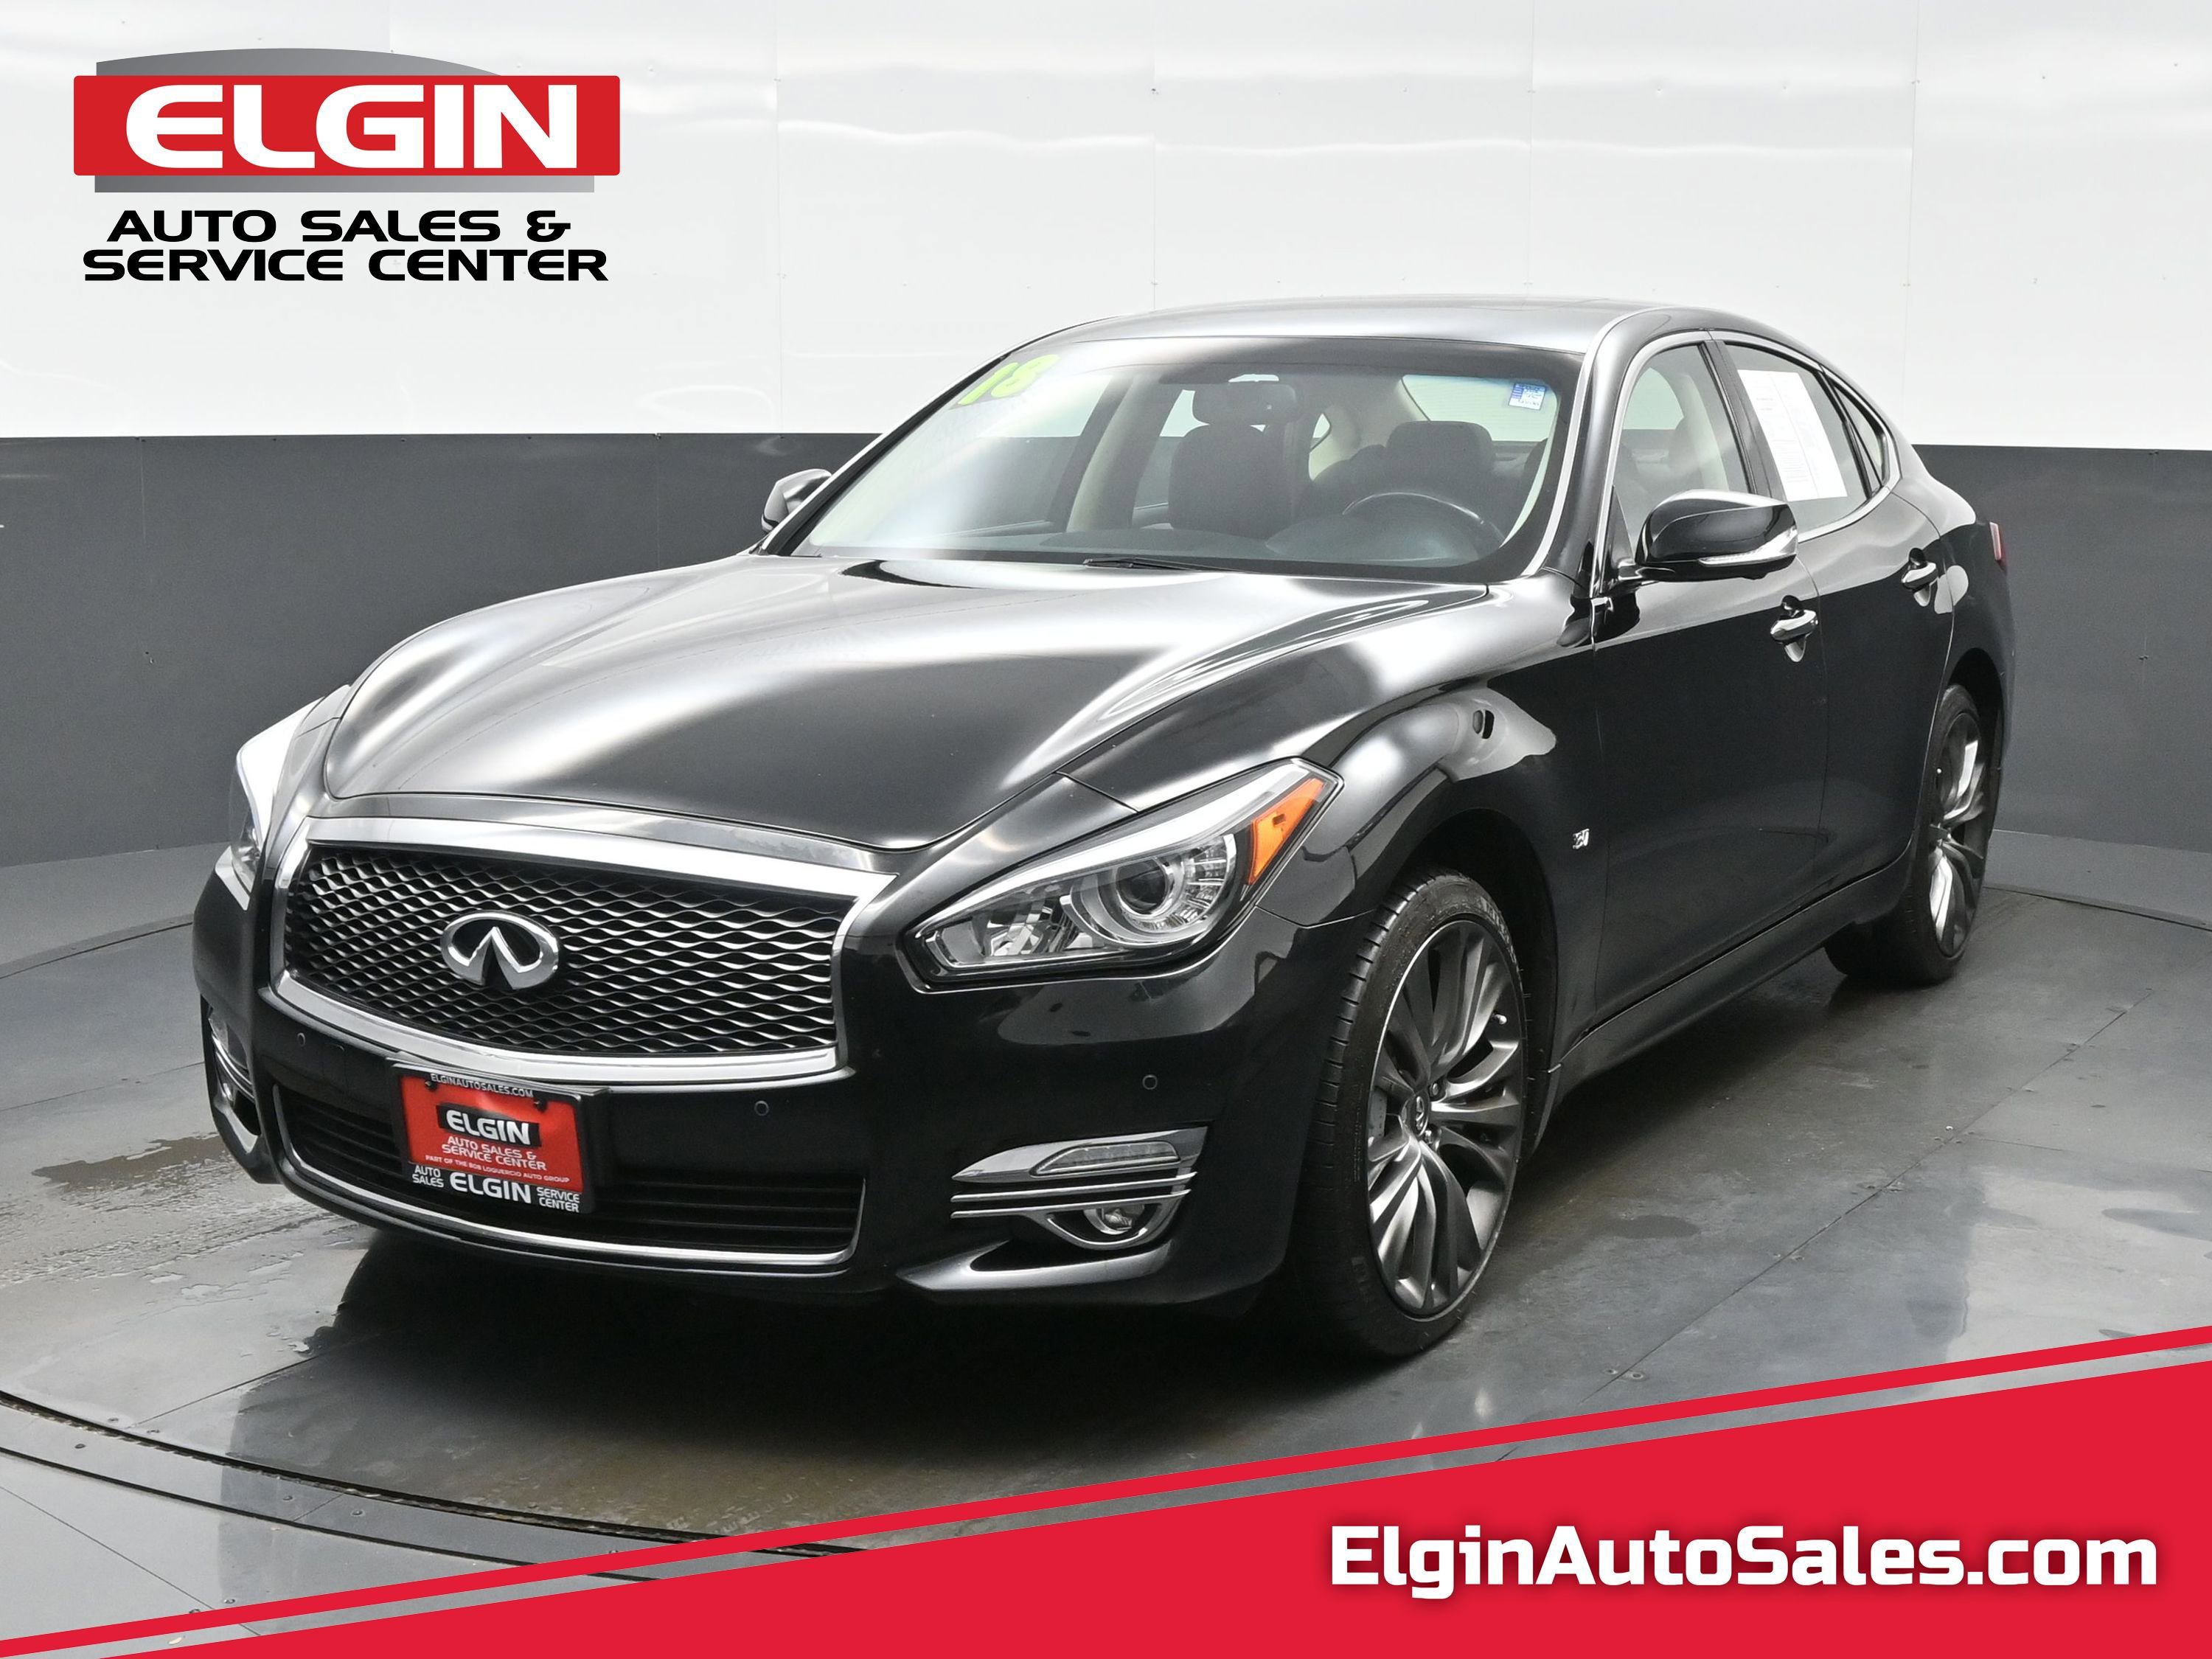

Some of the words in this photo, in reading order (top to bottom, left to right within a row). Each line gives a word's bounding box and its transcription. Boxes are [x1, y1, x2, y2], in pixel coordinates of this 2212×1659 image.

[431, 1073, 534, 1097] ELGINAUTOSALES.COM
[446, 1110, 531, 1145] ELGIN
[442, 1144, 492, 1163] SERVICE
[495, 1155, 547, 1171] CENTER
[448, 1135, 478, 1151] AUTO
[481, 1144, 522, 1158] SALES
[526, 1151, 537, 1161] &
[425, 1155, 442, 1163] PART
[412, 1174, 444, 1188] SALES
[414, 1164, 441, 1178] AUTO
[450, 1172, 532, 1203] ELGIN
[536, 1186, 580, 1203] SERVICE
[538, 1197, 580, 1213] CENTER
